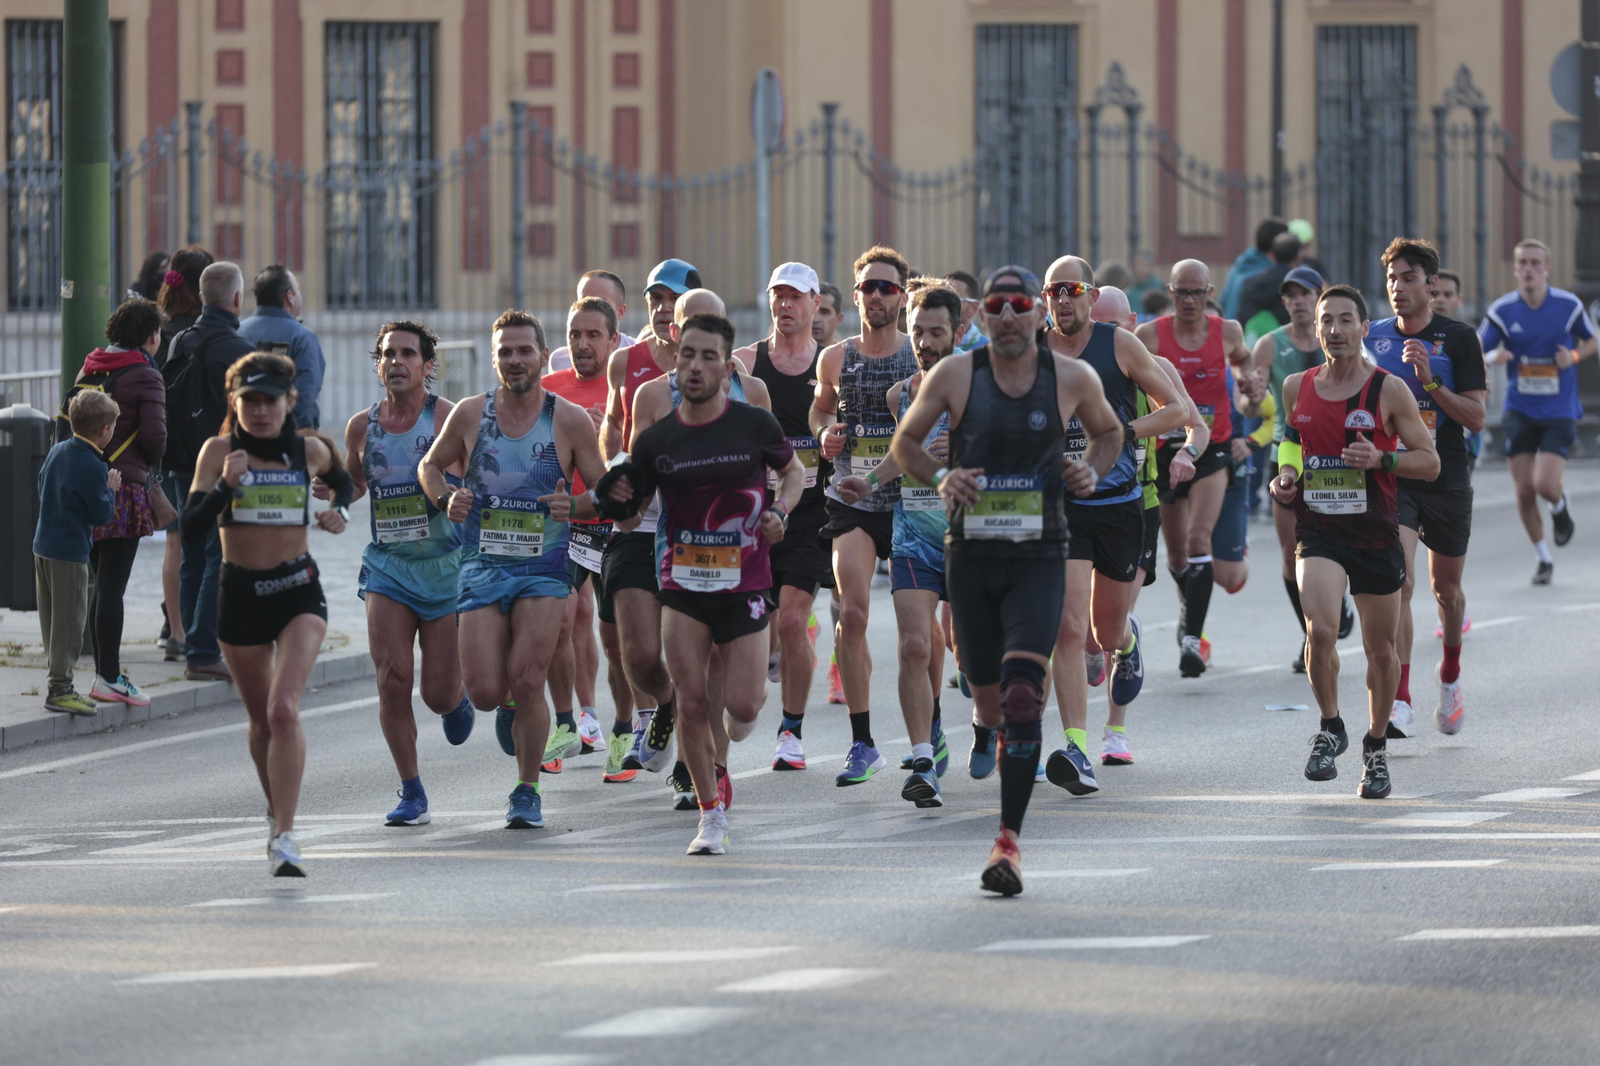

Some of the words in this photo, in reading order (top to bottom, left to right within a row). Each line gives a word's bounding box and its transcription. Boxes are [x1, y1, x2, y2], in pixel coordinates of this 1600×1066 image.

[790, 439, 813, 447] RICH
[868, 445, 889, 454] 1457
[256, 472, 297, 483] ZURICH
[1323, 477, 1344, 487] 1043
[989, 478, 1034, 488] ZURICH
[382, 485, 416, 497] ZURICH
[1311, 492, 1336, 500] LEONEL
[502, 499, 537, 510] ZURICH
[386, 504, 407, 516] 1116
[257, 511, 283, 520] DIANA
[398, 516, 427, 528] ROMERO
[501, 518, 523, 529] 1178
[984, 518, 1022, 527] RICARDO
[587, 524, 609, 533] RICH
[483, 531, 508, 541] FATIMA
[509, 533, 515, 541] Y
[516, 534, 540, 543] MARIO
[572, 532, 592, 545] 1862
[693, 534, 733, 544] ZURICH
[694, 554, 717, 565] 3674
[690, 569, 721, 579] DANIELO
